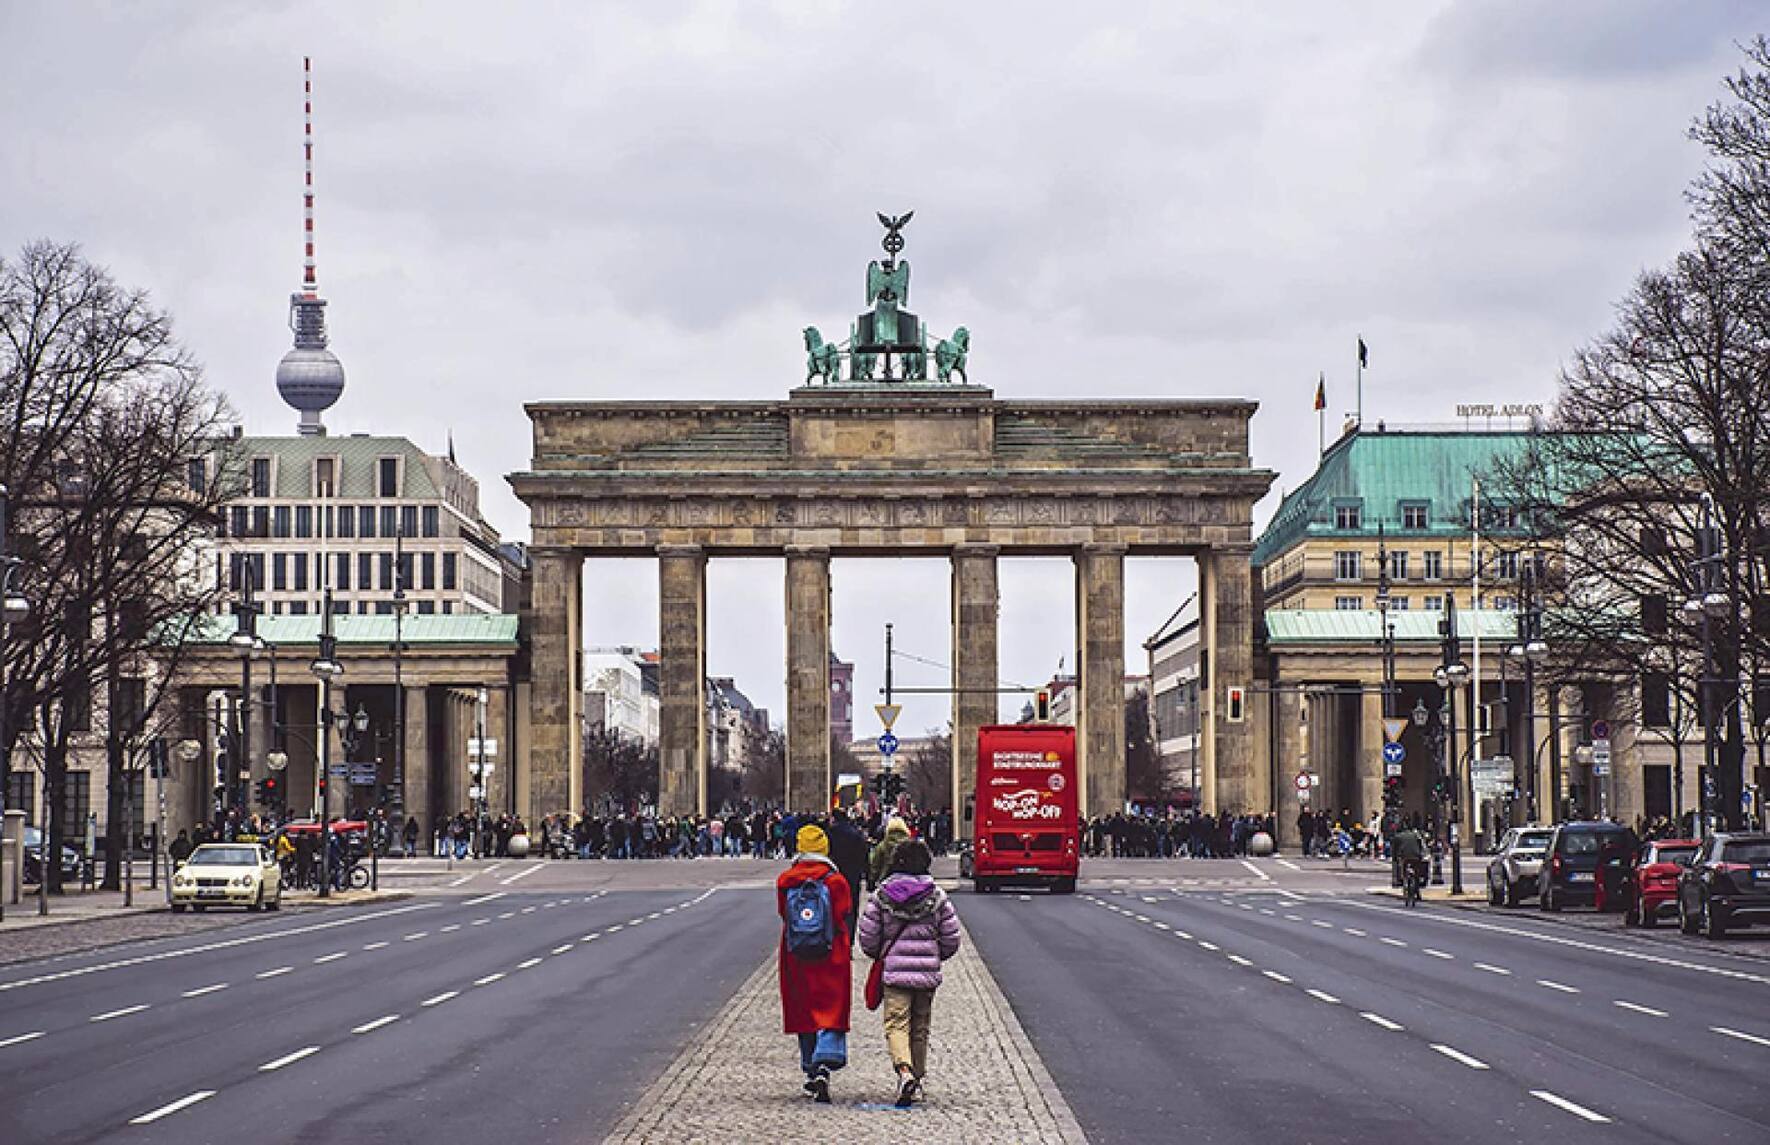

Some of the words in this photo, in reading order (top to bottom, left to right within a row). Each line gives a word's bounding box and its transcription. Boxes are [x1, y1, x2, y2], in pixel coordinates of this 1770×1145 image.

[1457, 404, 1498, 416] HOTEL
[1501, 404, 1544, 416] ADLON
[993, 796, 1039, 812] HOP-ON
[1012, 805, 1062, 819] HOP-OFF
